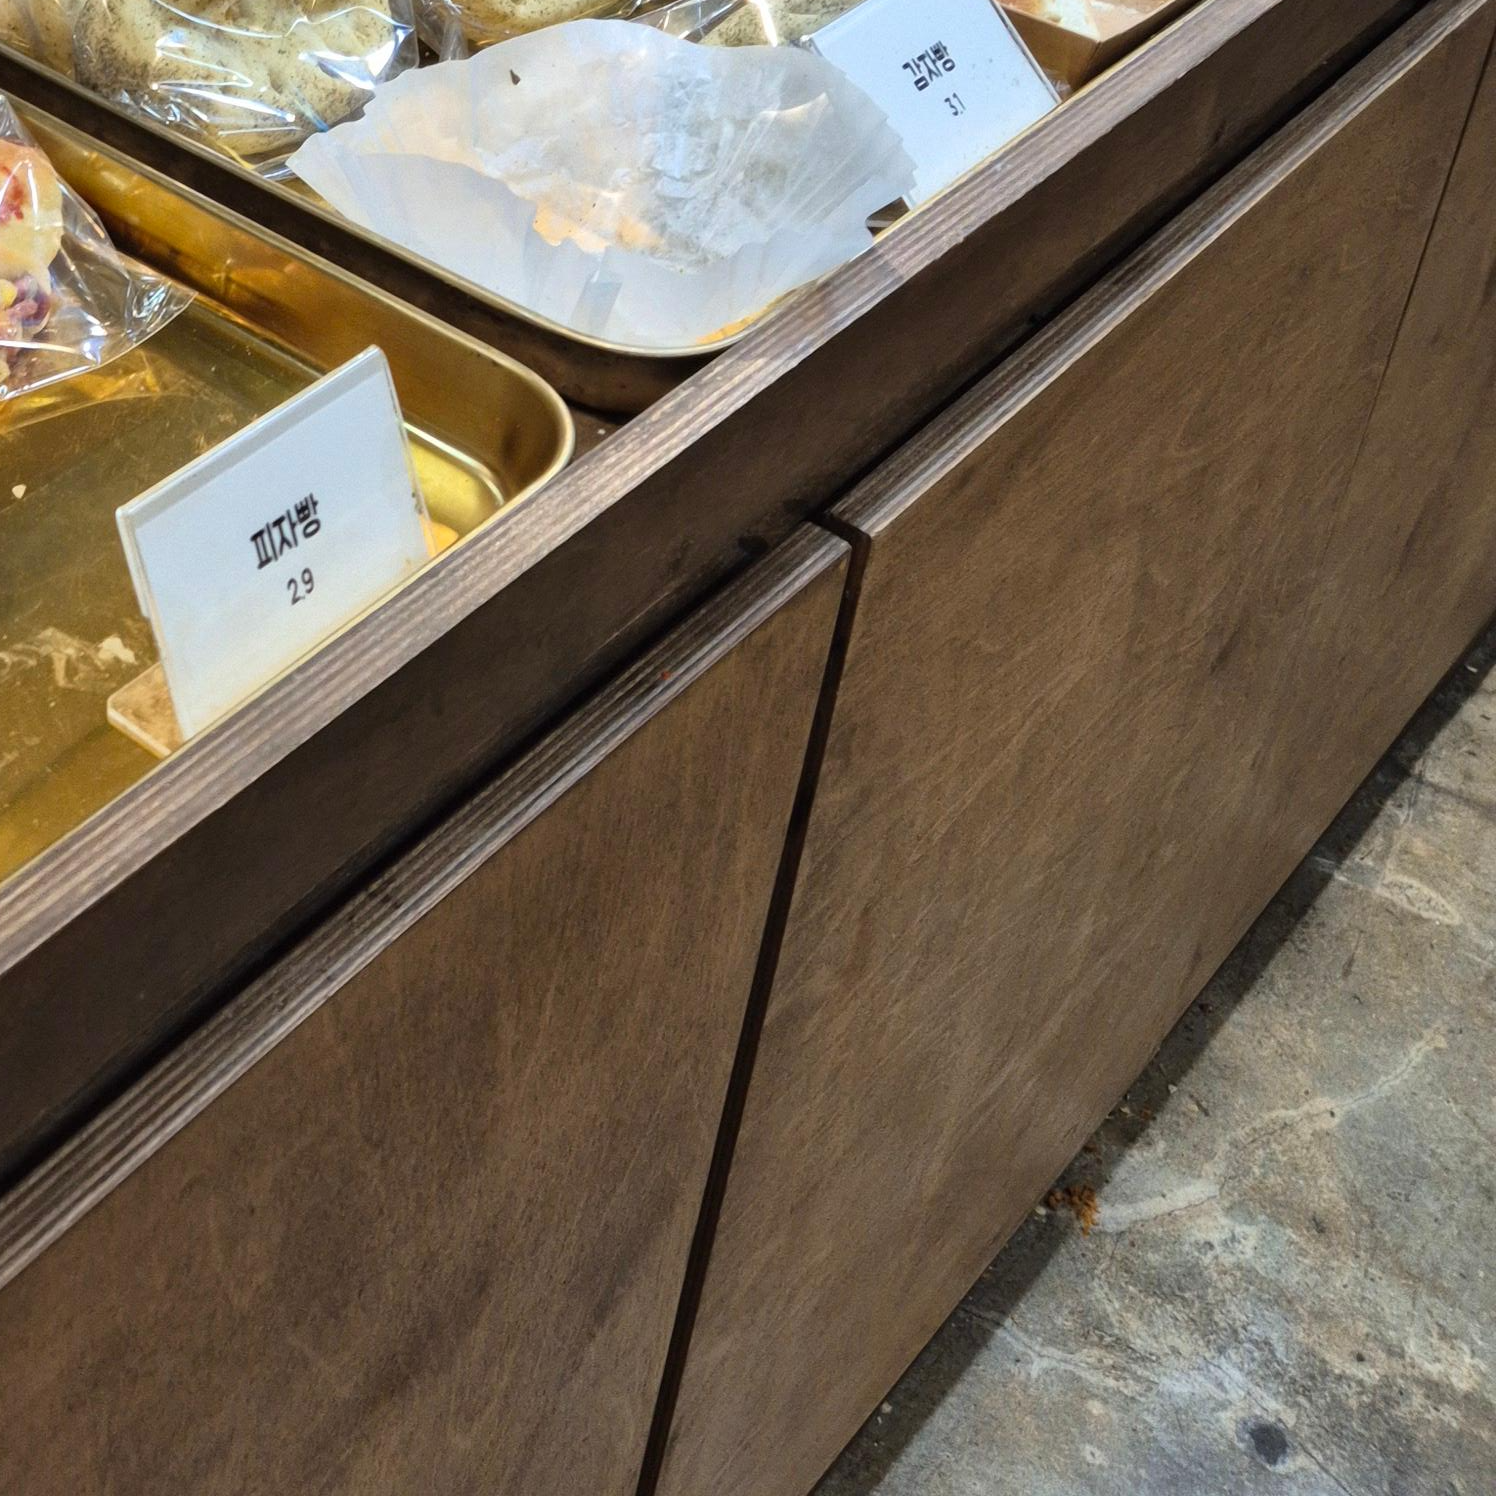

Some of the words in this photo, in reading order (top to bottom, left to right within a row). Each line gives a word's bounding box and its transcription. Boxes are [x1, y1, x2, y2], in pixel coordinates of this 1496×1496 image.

[902, 40, 956, 91] 감자빵
[944, 92, 966, 116] 3.1
[250, 493, 322, 570] 피자빵
[286, 567, 315, 606] 2.9
